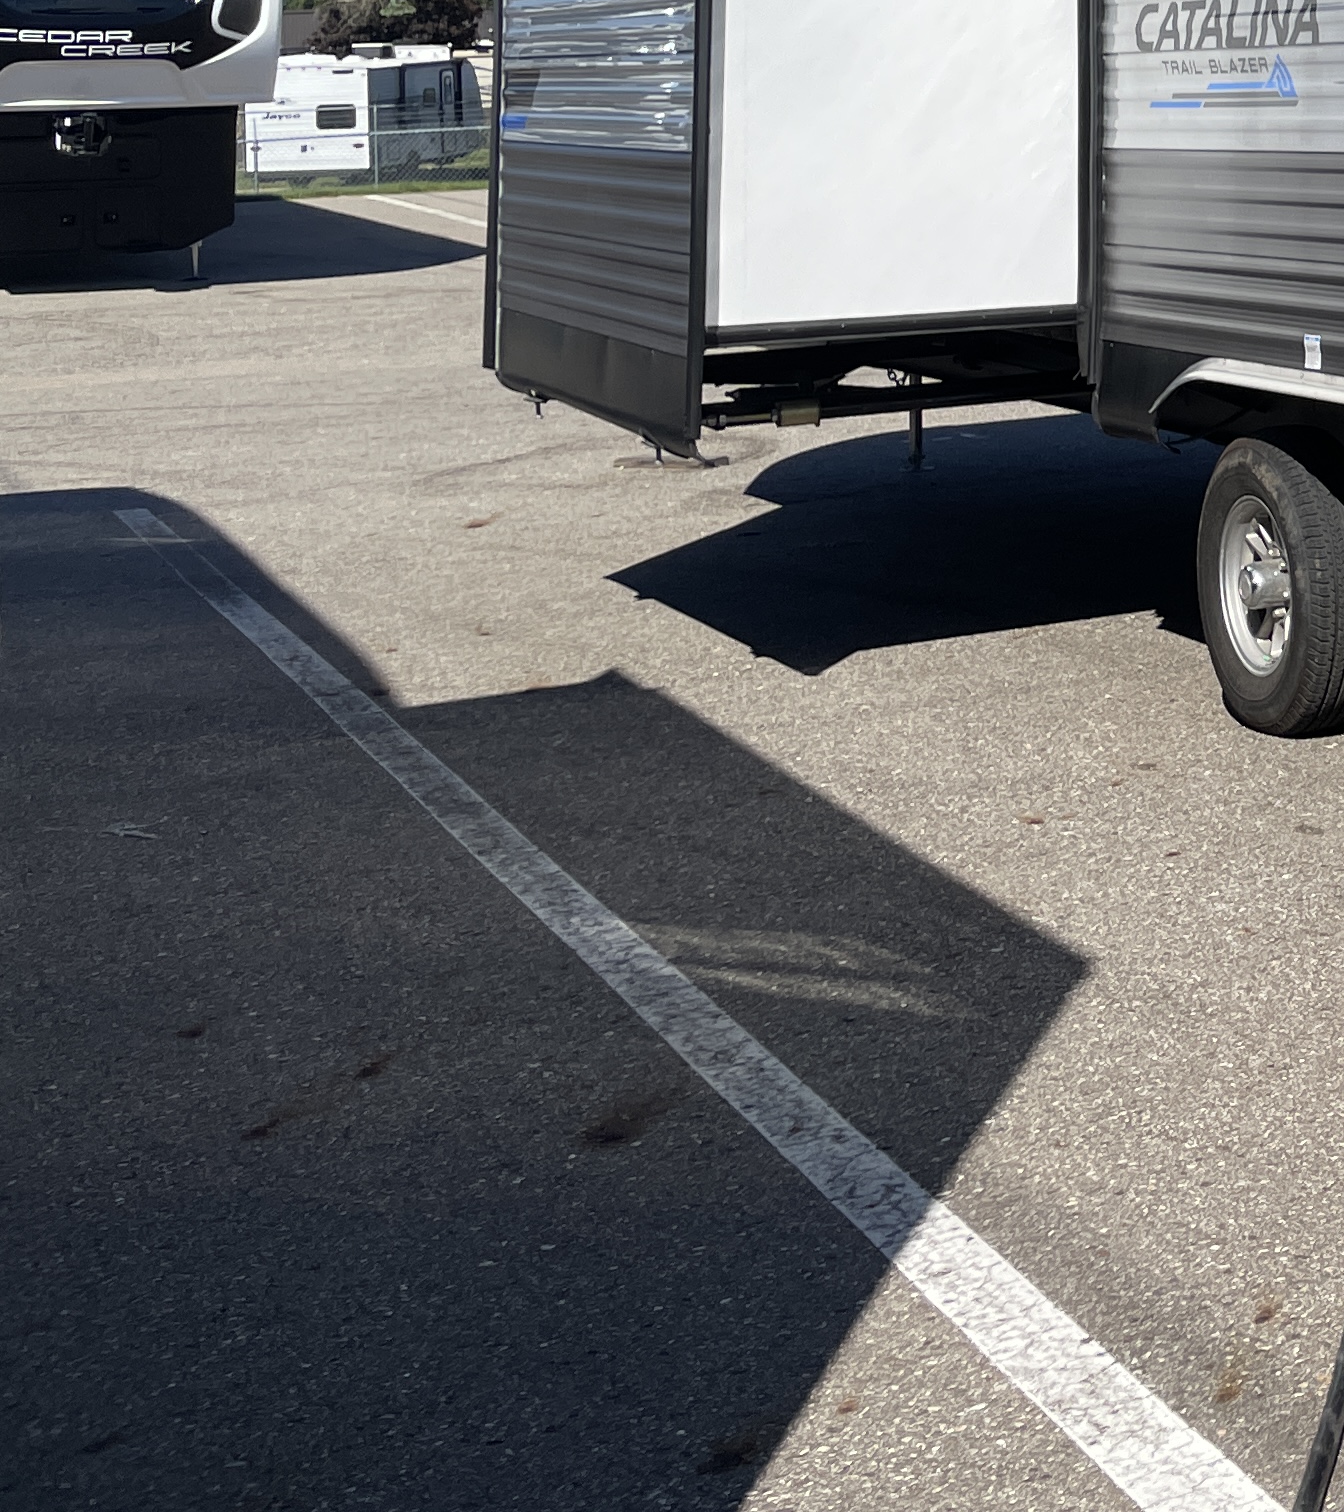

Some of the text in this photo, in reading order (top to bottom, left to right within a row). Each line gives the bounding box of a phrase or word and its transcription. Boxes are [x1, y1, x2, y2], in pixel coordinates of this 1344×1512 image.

[0, 28, 133, 44] CEDAR
[60, 41, 193, 57] CREEK
[1161, 56, 1270, 76] TRAIL BLAZER
